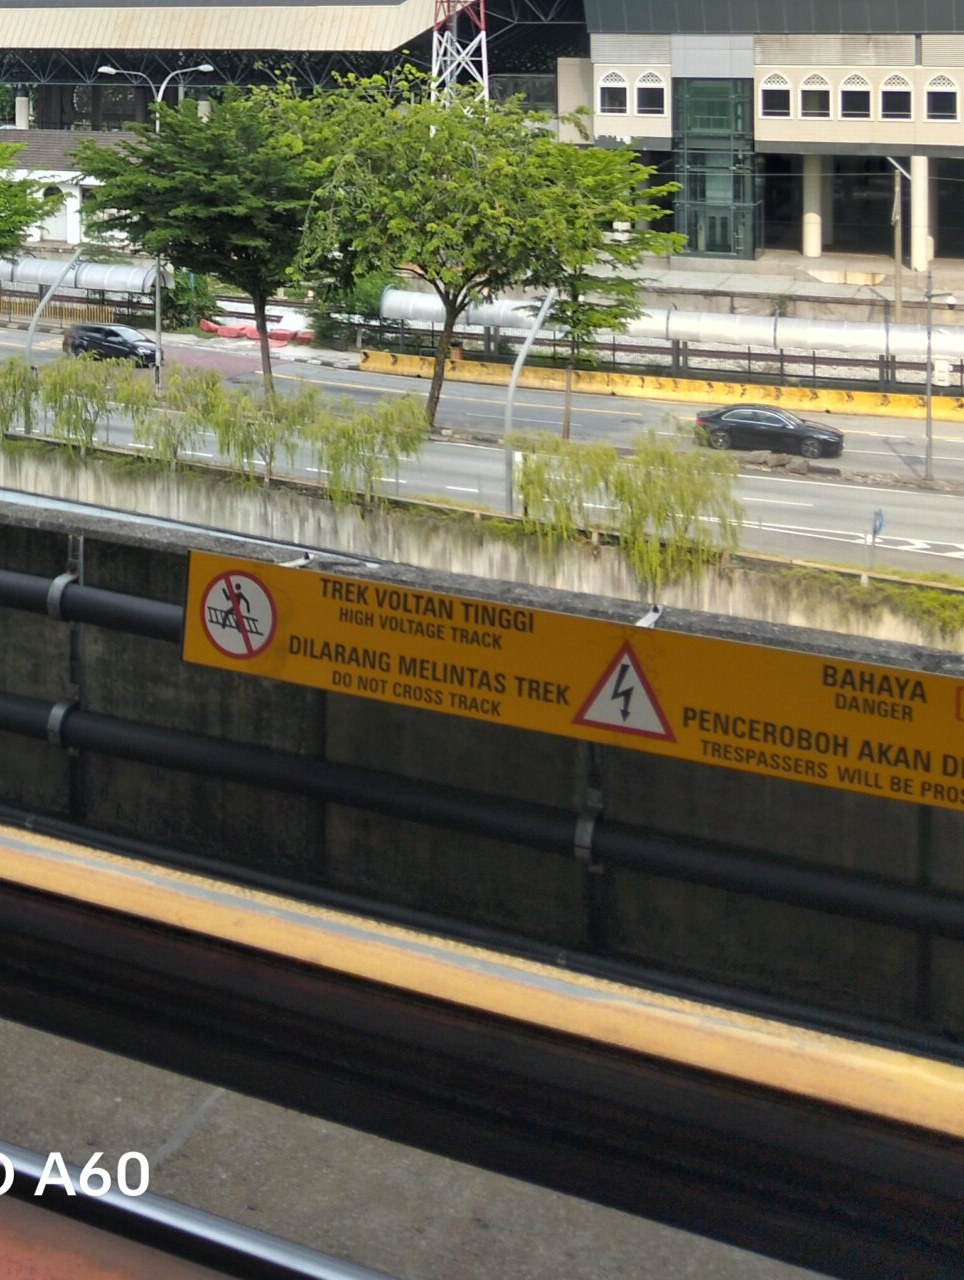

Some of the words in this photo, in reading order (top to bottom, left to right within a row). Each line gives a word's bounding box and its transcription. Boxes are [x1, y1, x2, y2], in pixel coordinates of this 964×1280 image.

[320, 578, 368, 606] TREK
[375, 587, 455, 620] VOLTAN
[461, 602, 535, 633] TINGGI
[339, 607, 375, 628] HIGH
[379, 615, 445, 640] VOLTAGE
[450, 626, 503, 650] TRACK
[288, 635, 391, 673] DILARANG
[399, 655, 506, 694] MELINTAS
[514, 677, 570, 706] TREK
[332, 670, 353, 688] DO
[357, 675, 387, 696] NOT
[392, 682, 443, 706] CROSS
[449, 693, 501, 717] TRACK
[822, 664, 928, 704] BAHAYA
[834, 693, 914, 722] DANGER
[683, 706, 849, 758] PENCEROBOH
[858, 740, 931, 773] AKAN
[701, 739, 828, 780] TRESPASSERS
[837, 765, 883, 790] WILL
[890, 776, 914, 795] BE
